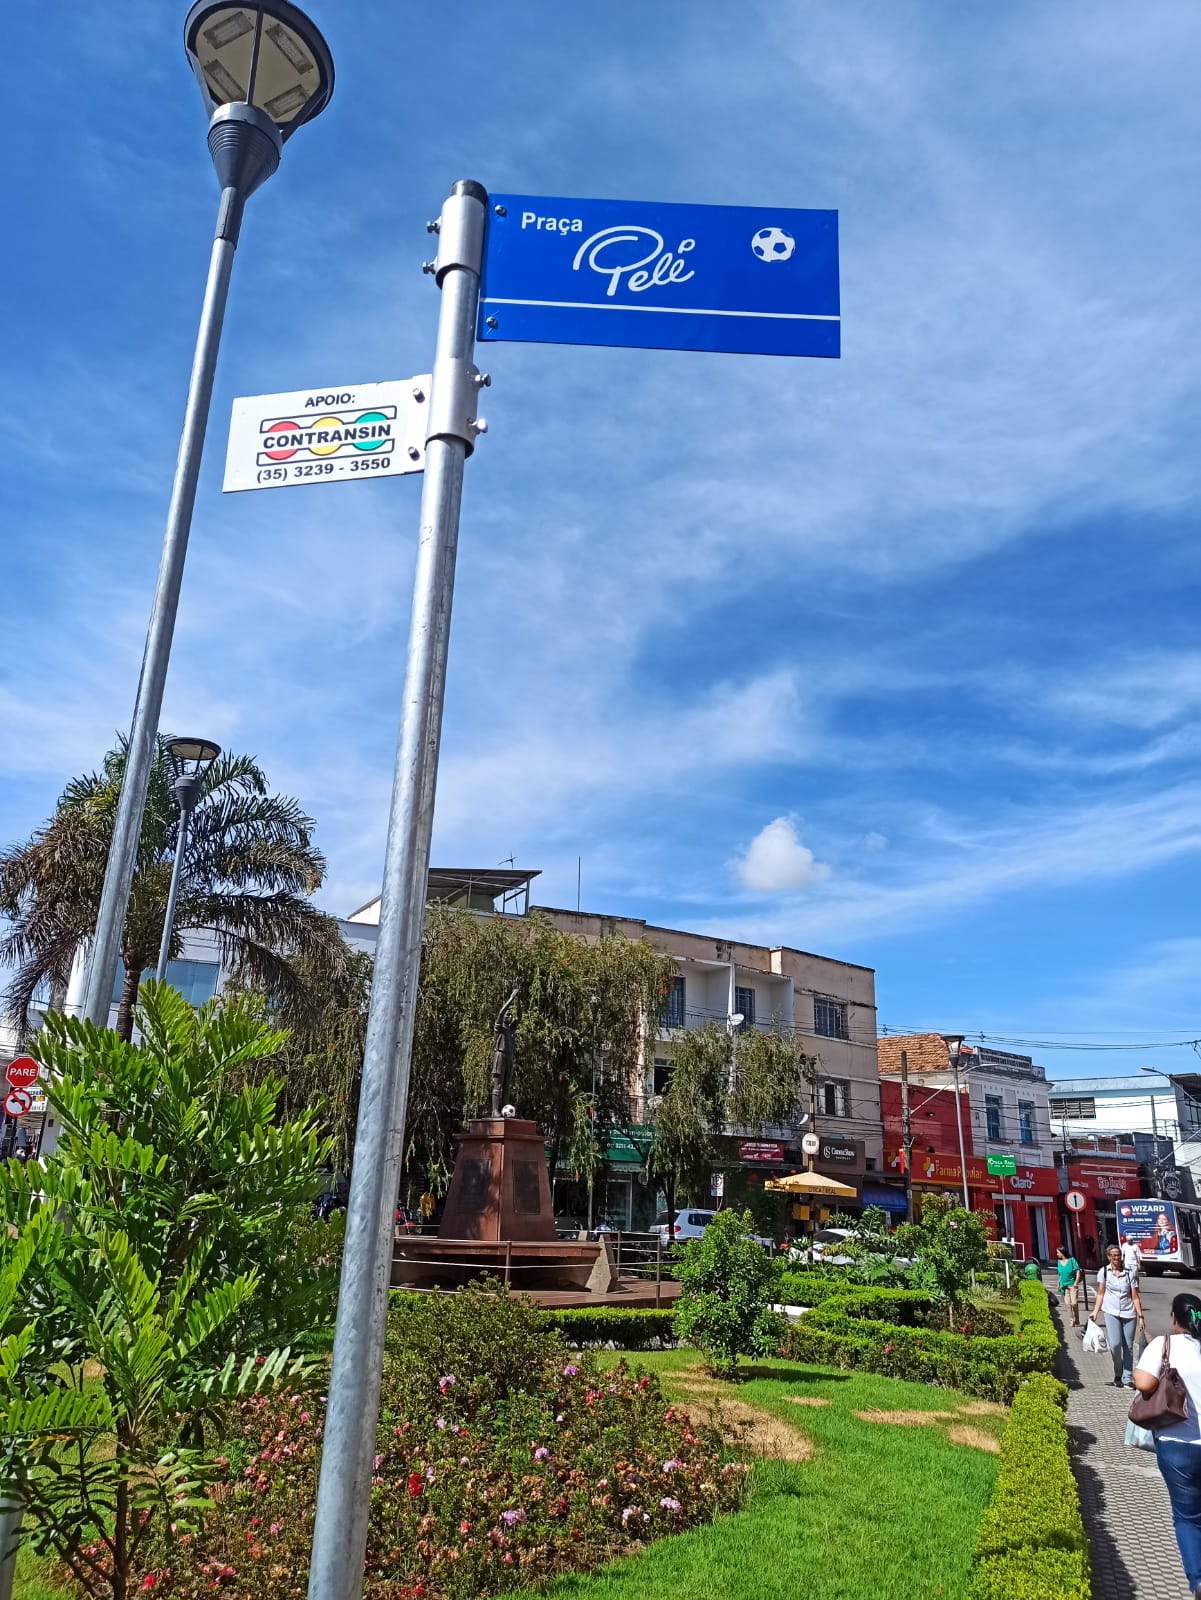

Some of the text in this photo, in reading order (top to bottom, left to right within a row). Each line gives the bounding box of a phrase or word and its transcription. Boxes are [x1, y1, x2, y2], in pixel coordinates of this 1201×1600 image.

[521, 211, 583, 236] Praça
[572, 225, 696, 297] Pelé
[304, 393, 356, 408] APOIO:
[263, 424, 391, 449] CONTRANSIN
[256, 467, 288, 484] (35)
[293, 463, 334, 478] 3239
[350, 457, 391, 472] 3550
[9, 1067, 37, 1077] PARE
[1010, 1175, 1032, 1189] Claro
